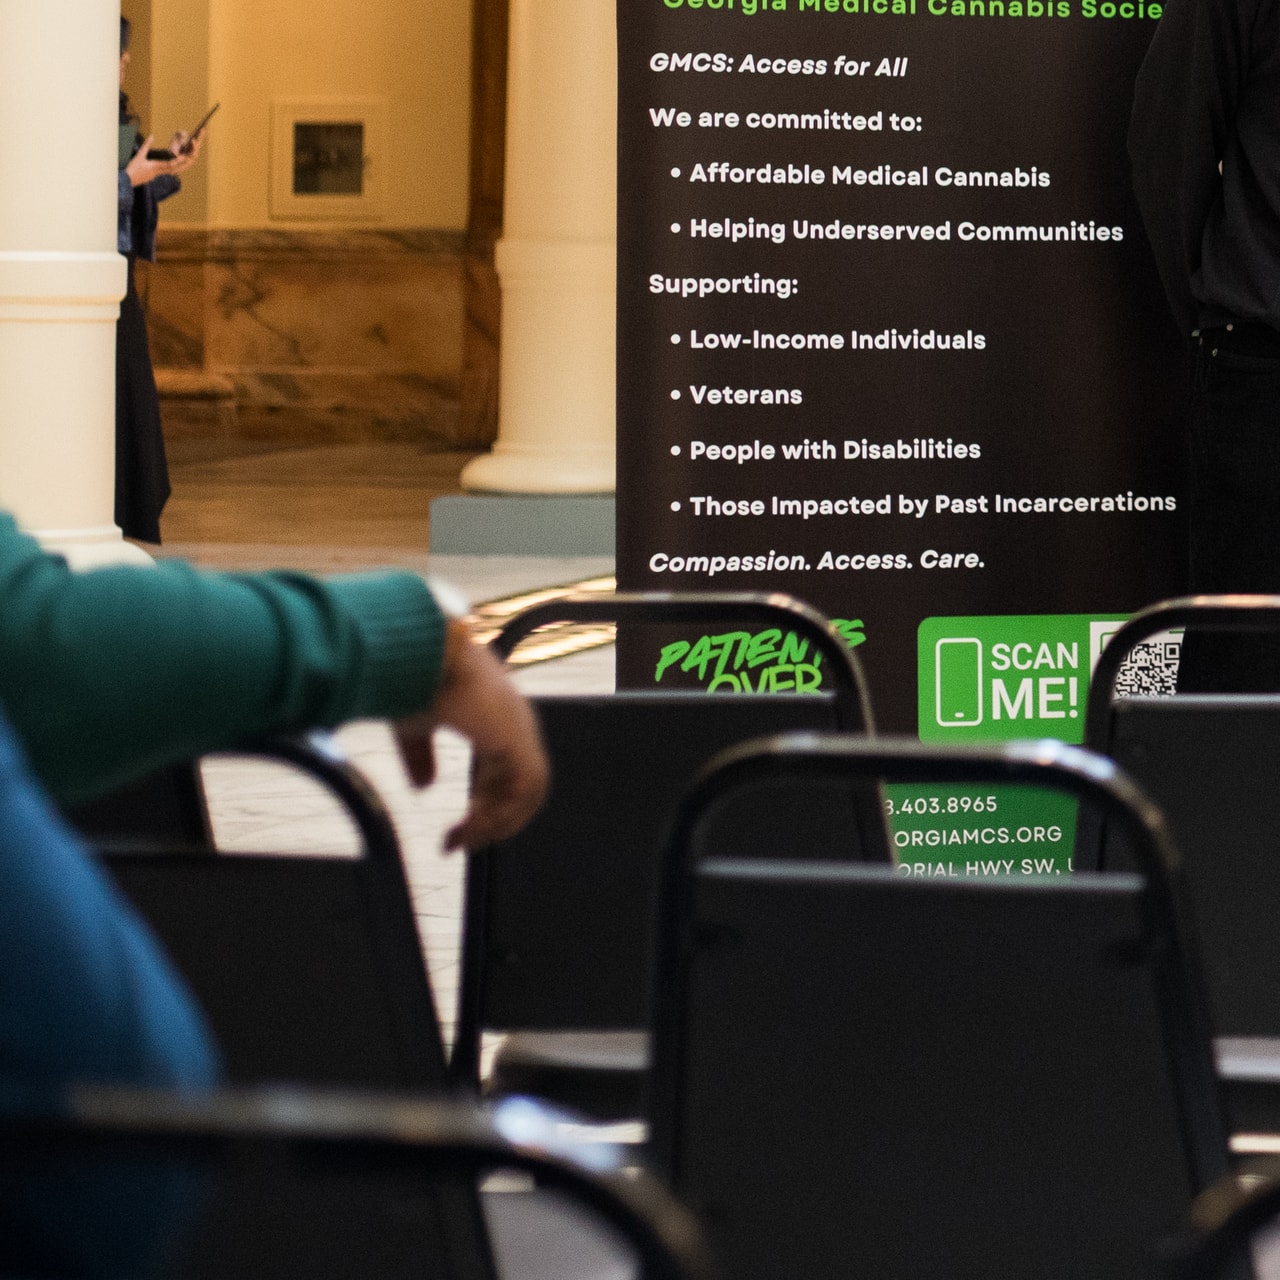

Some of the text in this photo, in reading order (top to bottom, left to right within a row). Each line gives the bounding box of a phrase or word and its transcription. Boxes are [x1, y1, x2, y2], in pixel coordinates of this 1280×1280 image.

[650, 53, 908, 76] GMCS: Access for All
[649, 108, 921, 131] We are committed to:
[690, 162, 1050, 187] Affordable Medical Cannabis
[691, 217, 1123, 243] Helping Underserved Communities
[650, 273, 798, 298] Supporting:
[691, 329, 985, 349] Low-Income Individuals
[690, 386, 802, 404] Veterans
[691, 438, 980, 464] People with Disabilities
[690, 491, 1176, 519] Those Impacted by Past Incarcerations
[649, 550, 984, 576] Compassion. Access. Care.
[992, 642, 1078, 670] SCAN
[992, 677, 1078, 720] ME!
[966, 859, 1014, 876] HWY
[1021, 858, 1060, 876] SW,
